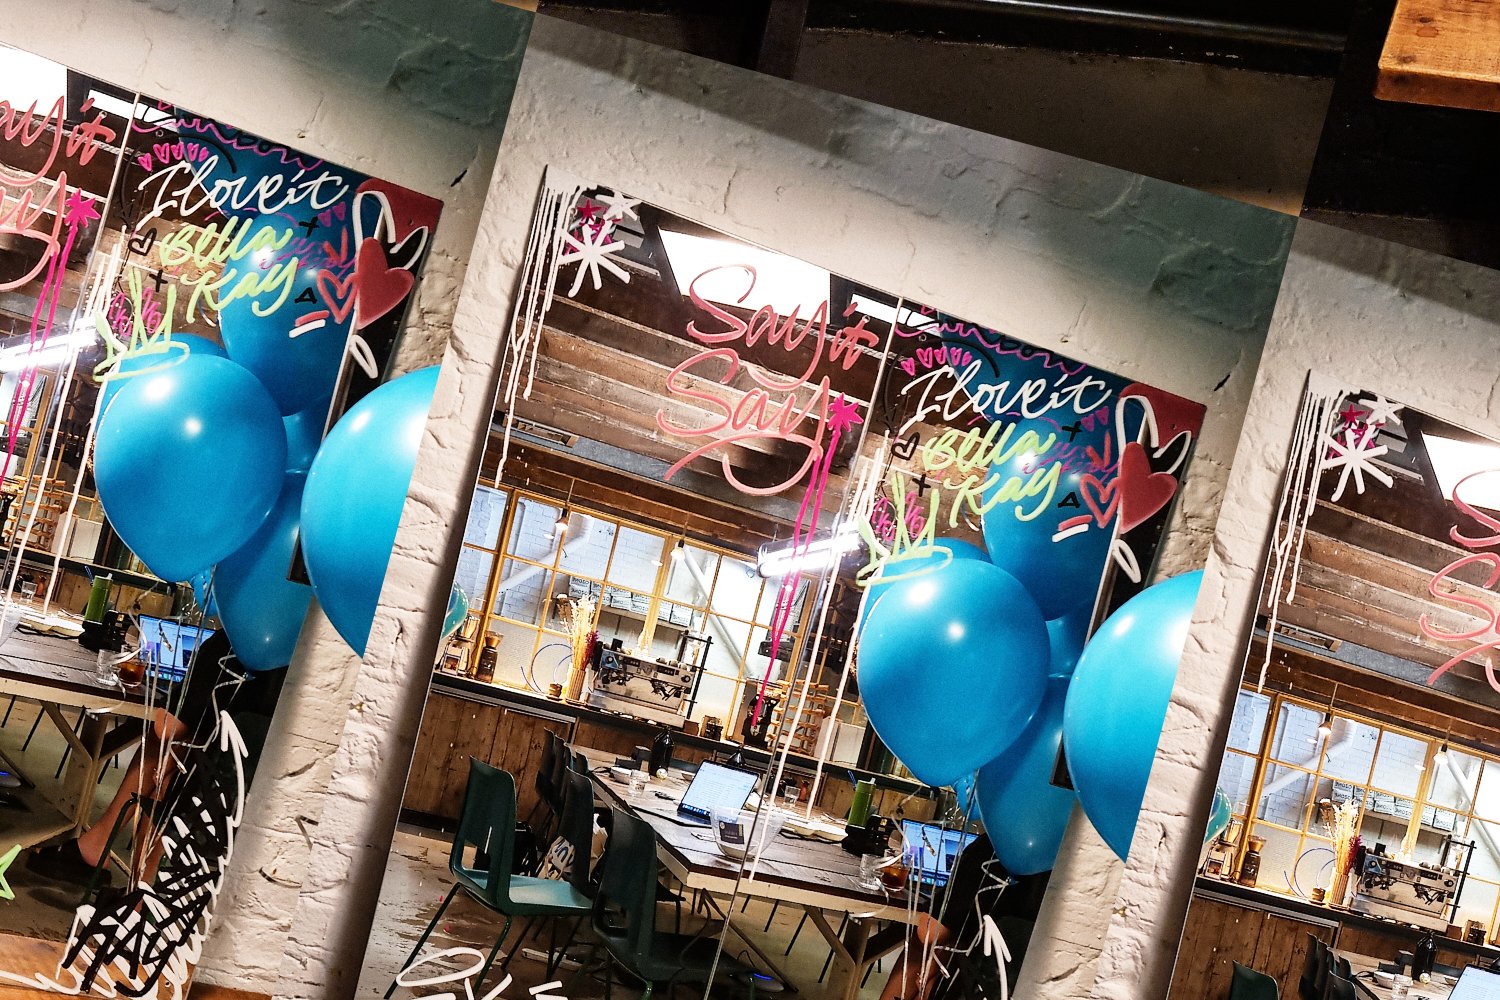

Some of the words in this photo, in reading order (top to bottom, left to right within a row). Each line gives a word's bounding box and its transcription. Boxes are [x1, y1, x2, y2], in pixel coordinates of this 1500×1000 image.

[66, 97, 117, 166] it
[158, 215, 294, 268] Bella
[180, 256, 300, 324] Kay
[686, 264, 829, 390] Say
[829, 302, 880, 370] it
[656, 348, 830, 496] Say
[921, 420, 1057, 472] Bella
[943, 460, 1063, 528] Kay
